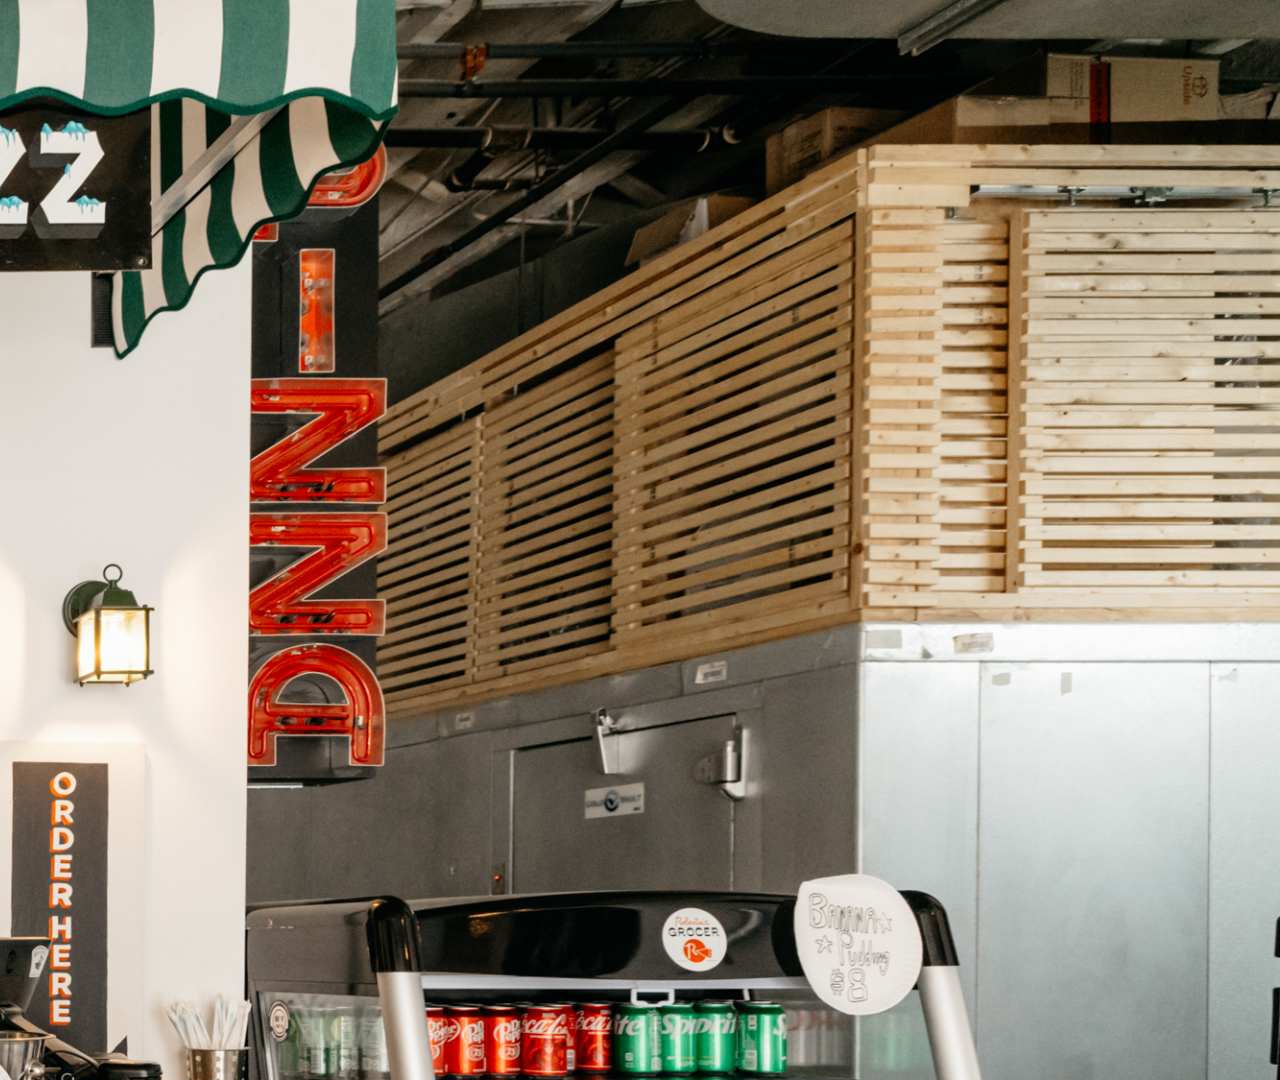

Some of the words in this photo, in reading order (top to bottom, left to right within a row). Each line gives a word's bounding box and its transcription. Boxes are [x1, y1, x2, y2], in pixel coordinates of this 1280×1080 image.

[50, 771, 77, 909] ORDER
[49, 915, 73, 1026] HERE
[668, 926, 720, 937] GROCER
